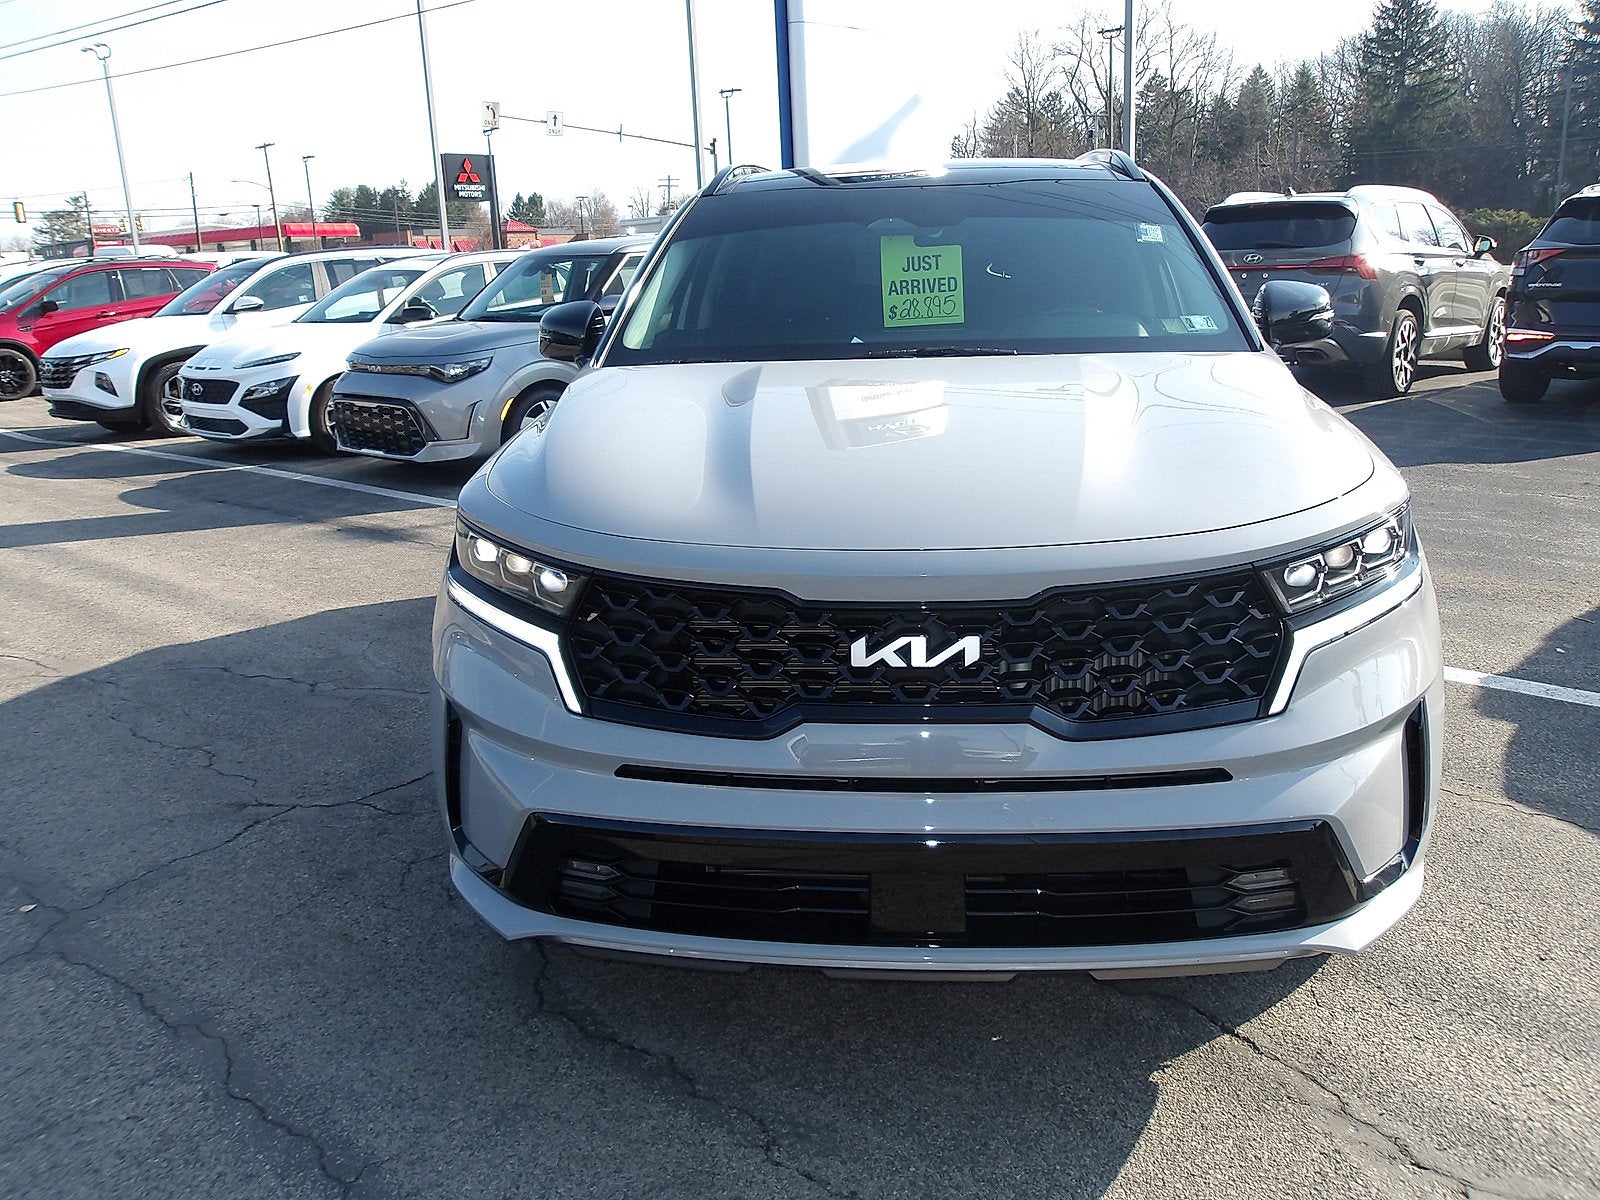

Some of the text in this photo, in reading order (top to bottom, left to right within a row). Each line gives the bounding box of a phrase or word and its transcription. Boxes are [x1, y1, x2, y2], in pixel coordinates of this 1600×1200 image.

[901, 254, 942, 273] JUST
[888, 276, 958, 296] ARRIVED
[851, 635, 980, 667] KIA
